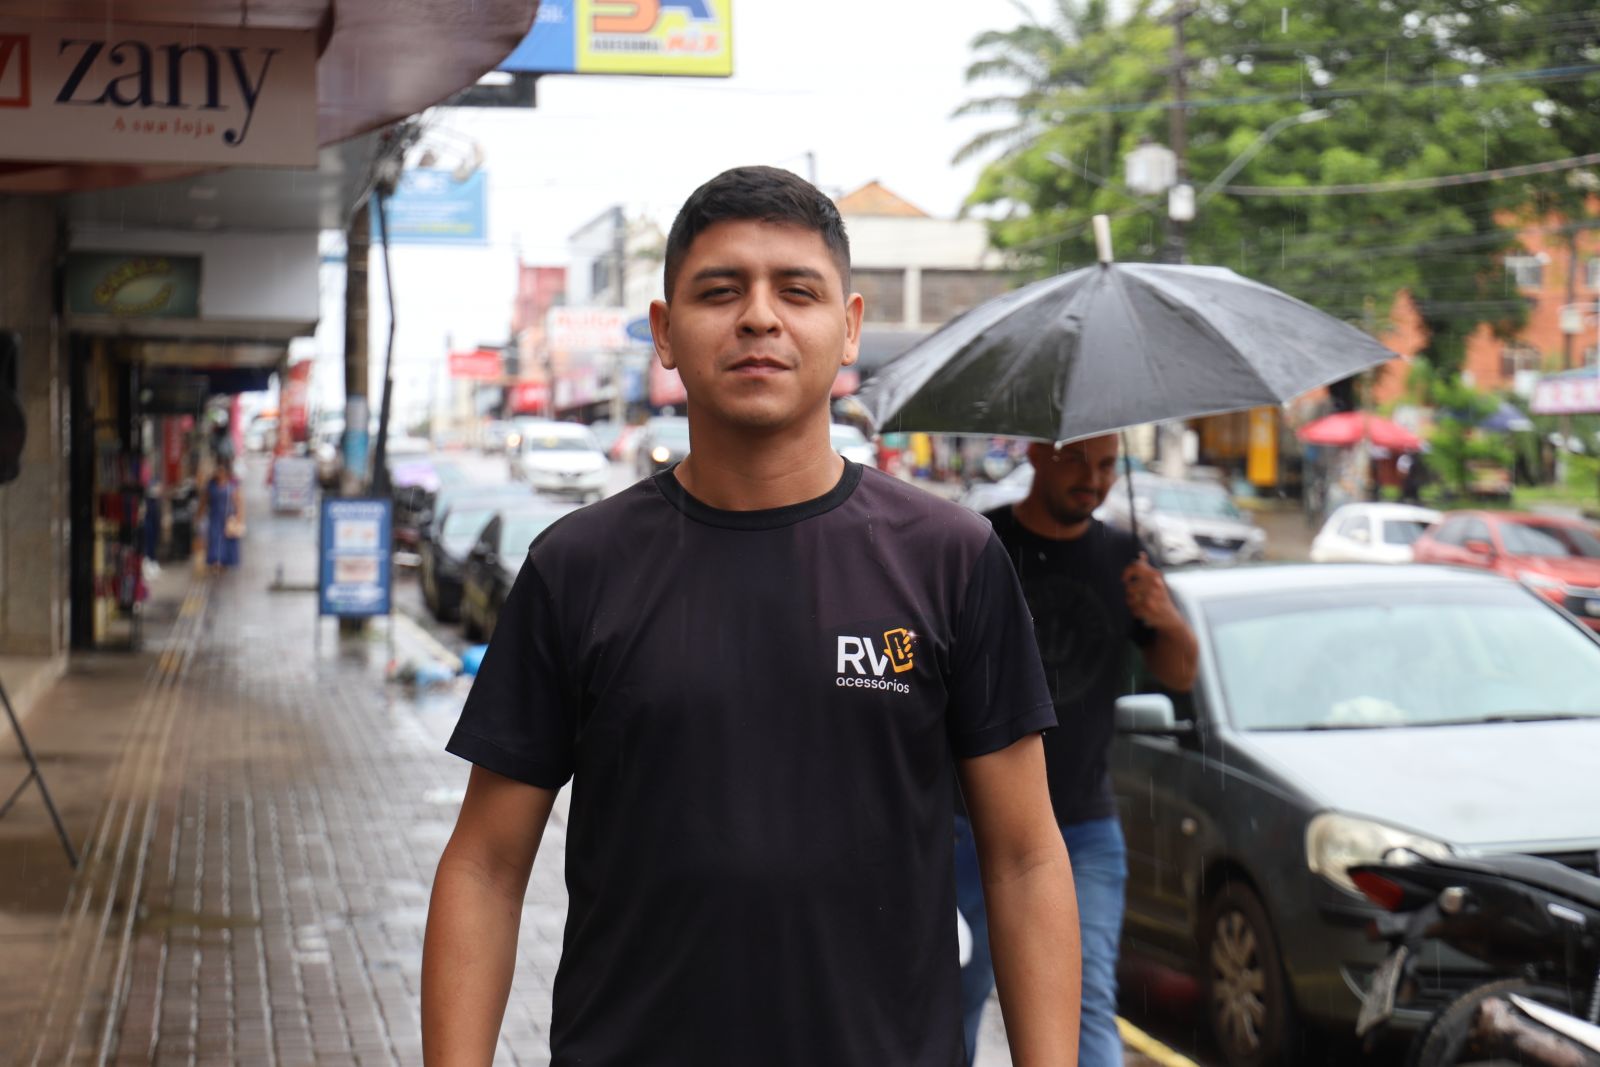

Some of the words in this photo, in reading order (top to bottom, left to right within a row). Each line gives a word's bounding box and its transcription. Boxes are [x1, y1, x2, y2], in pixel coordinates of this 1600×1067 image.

[54, 38, 281, 146] zany
[837, 635, 889, 676] RV
[836, 676, 910, 694] acessórios
